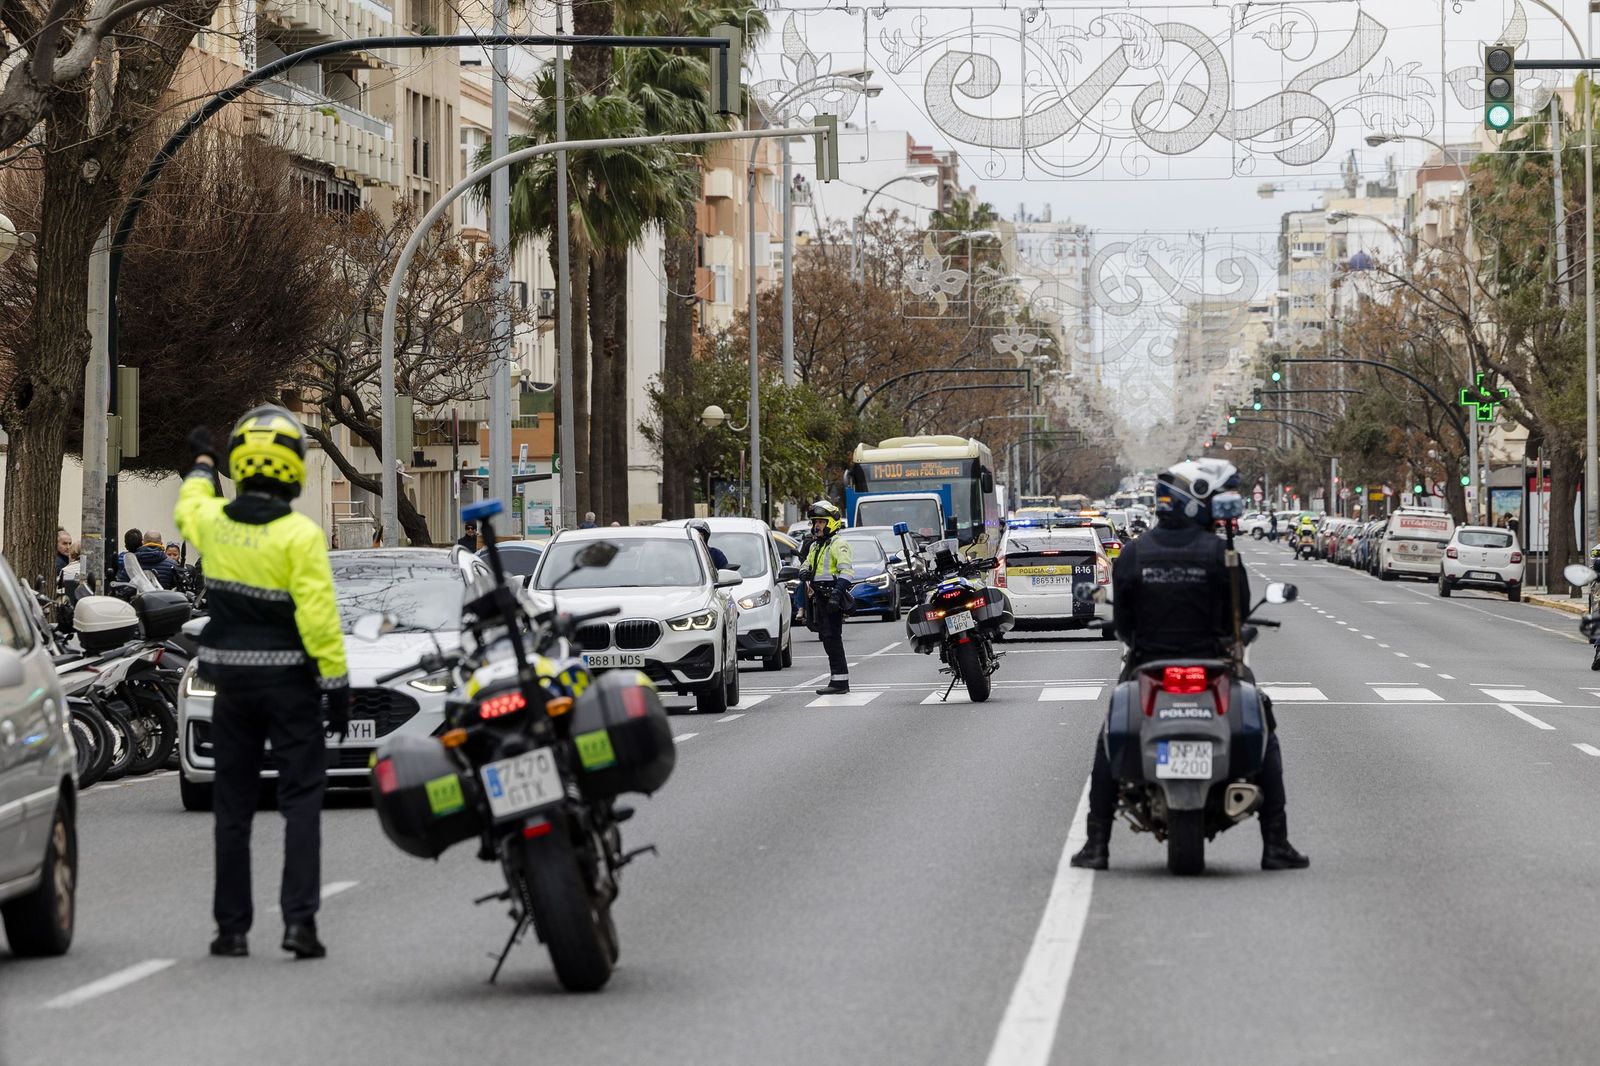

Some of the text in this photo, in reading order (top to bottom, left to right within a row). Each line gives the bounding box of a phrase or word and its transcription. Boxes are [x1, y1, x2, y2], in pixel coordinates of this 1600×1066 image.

[874, 463, 902, 479] M-010
[905, 469, 920, 477] SAN
[936, 466, 960, 476] NORTE
[1075, 565, 1091, 574] R-16
[1055, 576, 1070, 584] HYN
[951, 612, 971, 623] 2754
[588, 655, 641, 666] 8681 MDS
[498, 754, 550, 786] 7470
[1170, 760, 1210, 775] 4200
[507, 778, 547, 808] GTX
